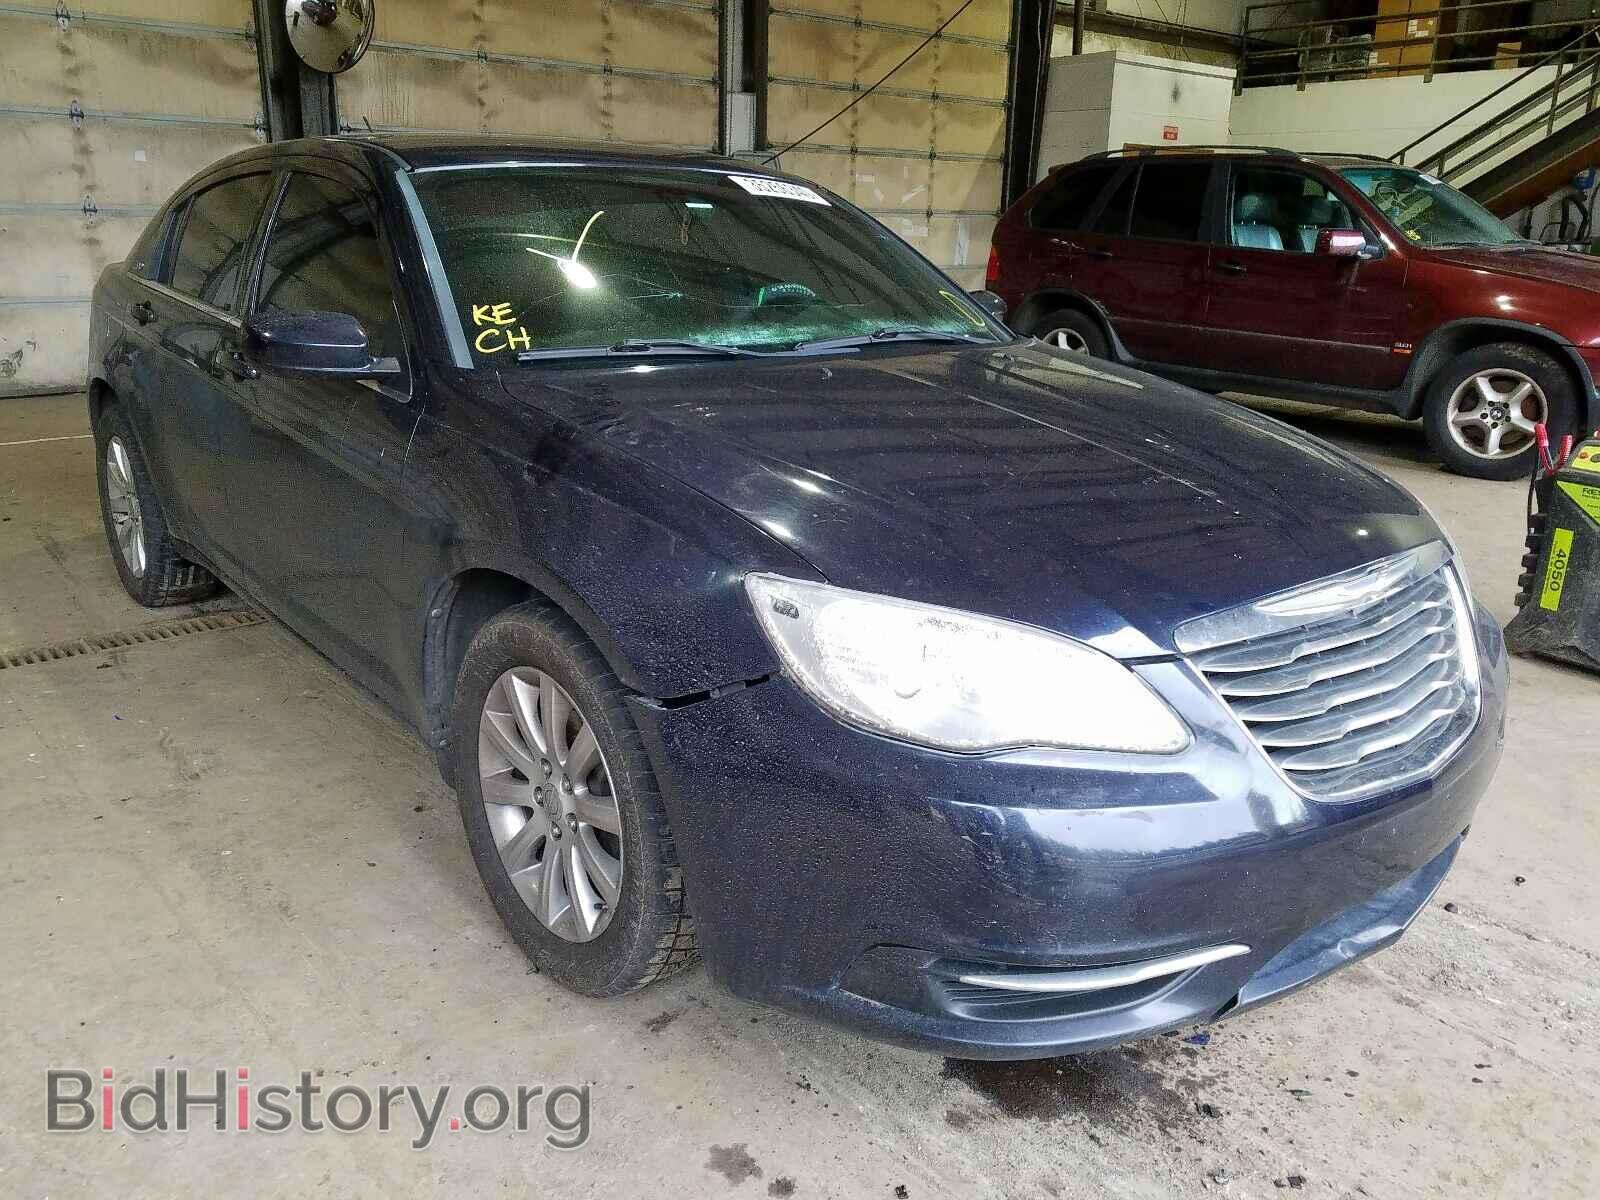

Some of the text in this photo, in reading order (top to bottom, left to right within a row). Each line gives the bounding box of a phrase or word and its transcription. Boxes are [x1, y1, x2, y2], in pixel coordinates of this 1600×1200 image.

[472, 302, 517, 326] KE
[475, 326, 531, 353] CH
[1549, 548, 1567, 592] 4050
